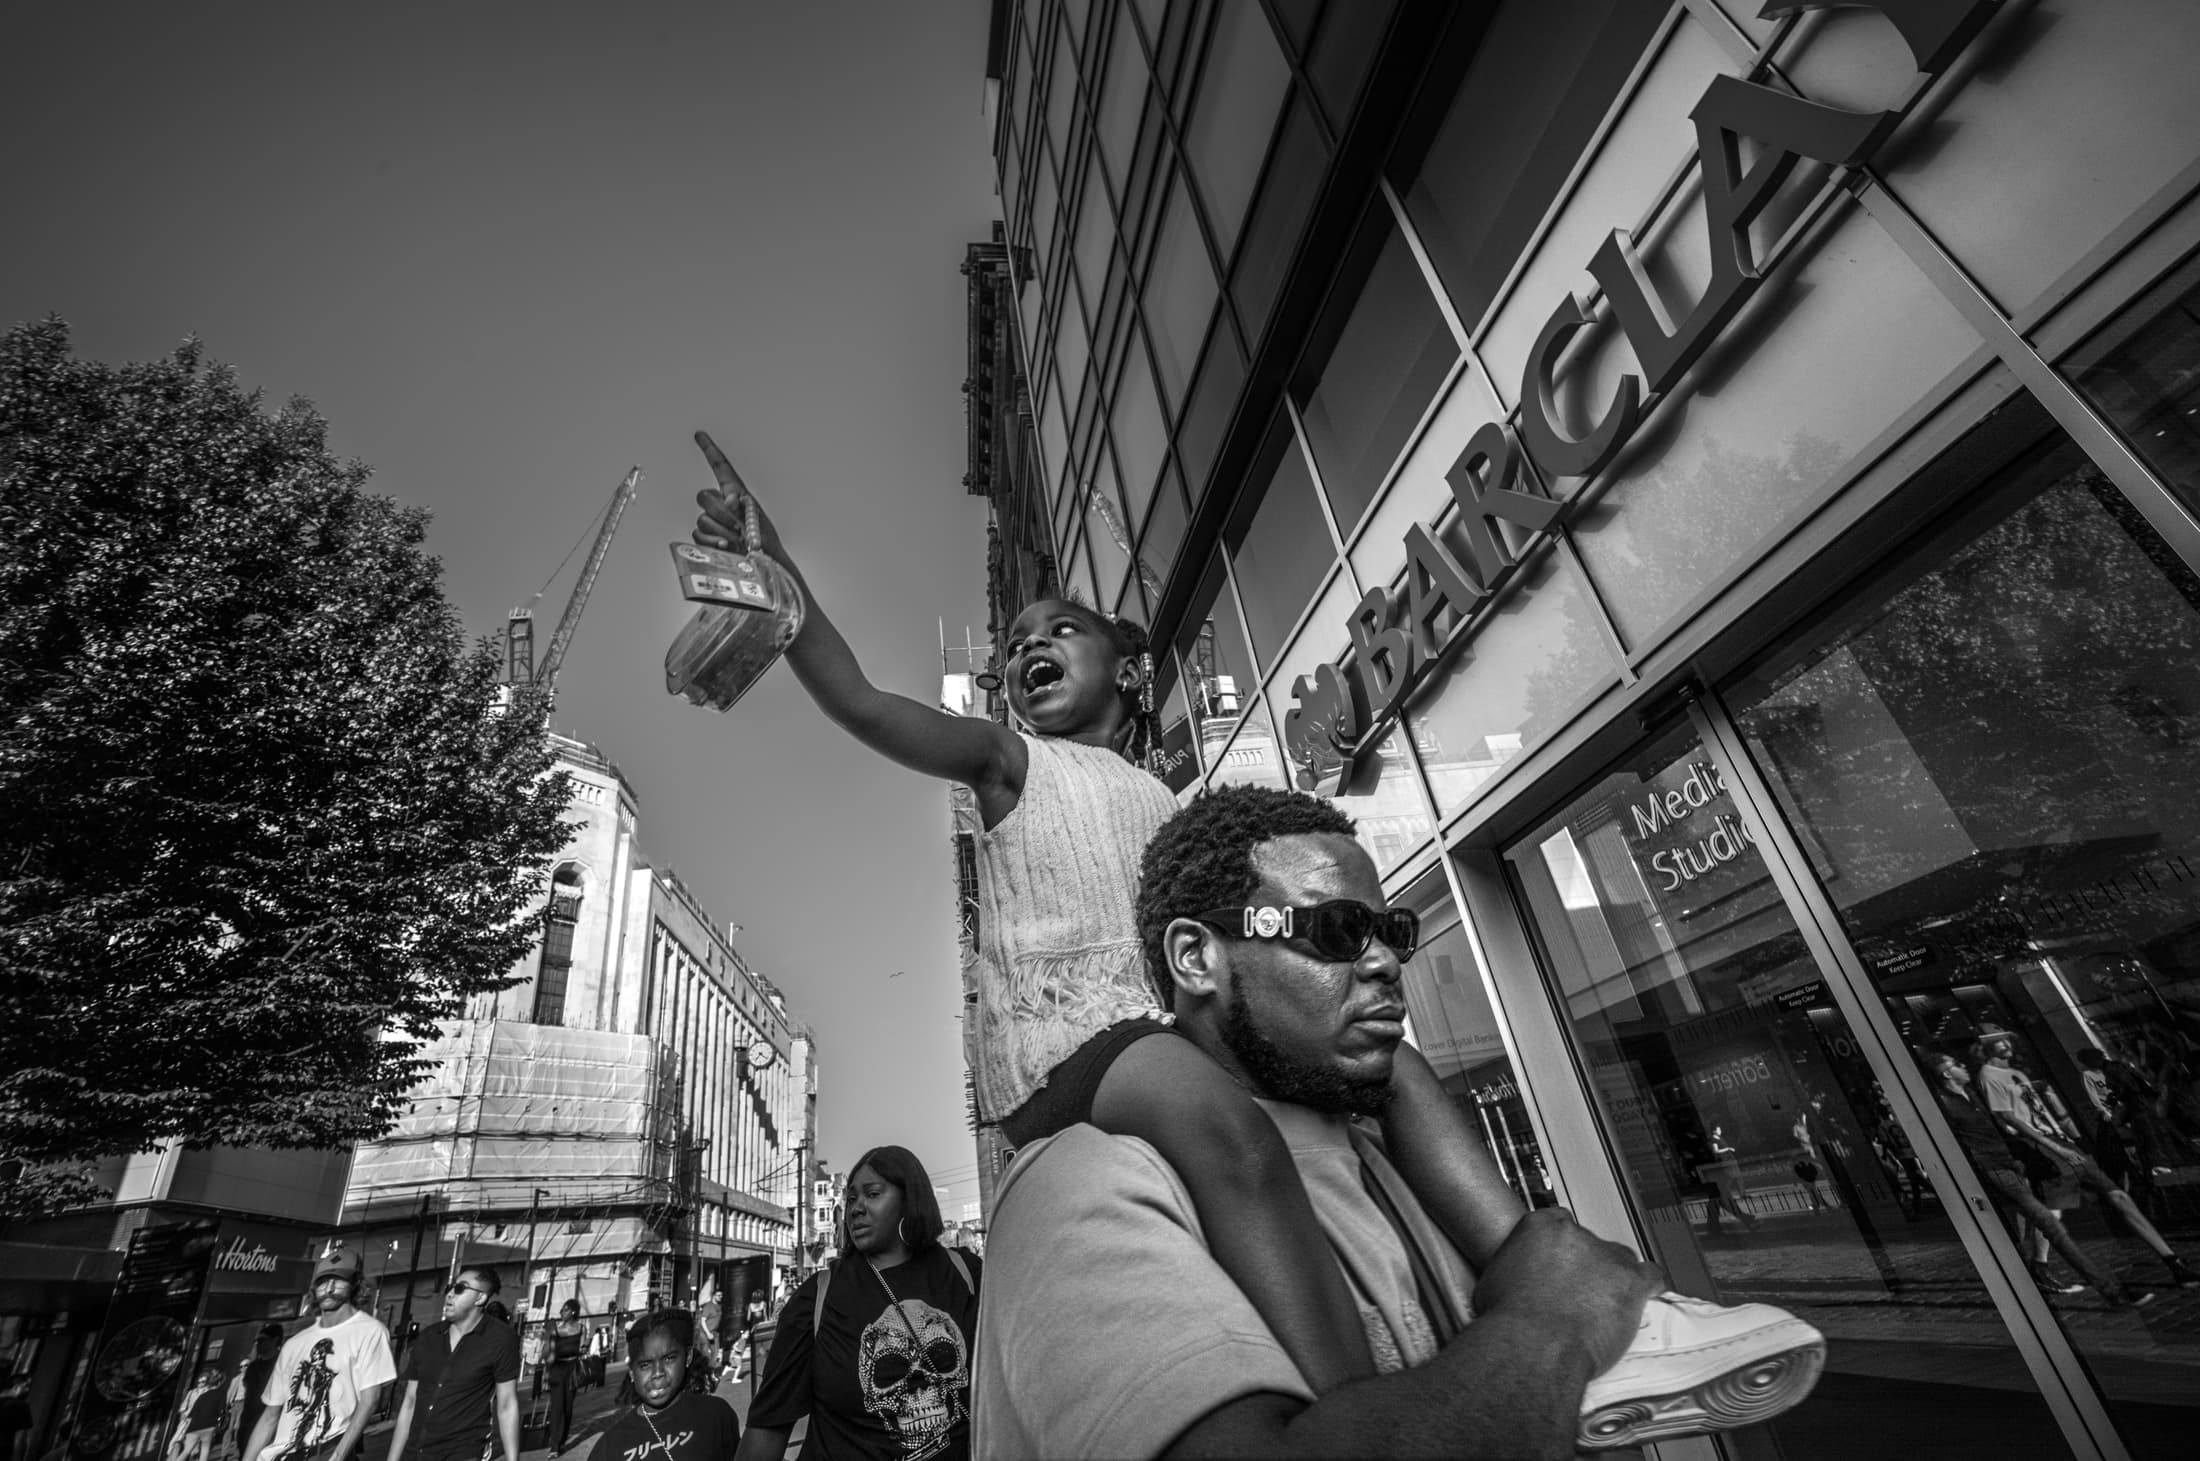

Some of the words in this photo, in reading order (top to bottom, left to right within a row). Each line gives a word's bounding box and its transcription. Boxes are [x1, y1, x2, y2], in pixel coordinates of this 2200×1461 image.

[1877, 953, 1908, 968] Automatic
[1910, 946, 1927, 957] Door
[1888, 964, 1906, 974] Keep
[1905, 958, 1922, 969] Clear
[1806, 984, 1819, 993] Door
[220, 1235, 279, 1273] Hortons
[623, 1430, 694, 1461] フリーレン
